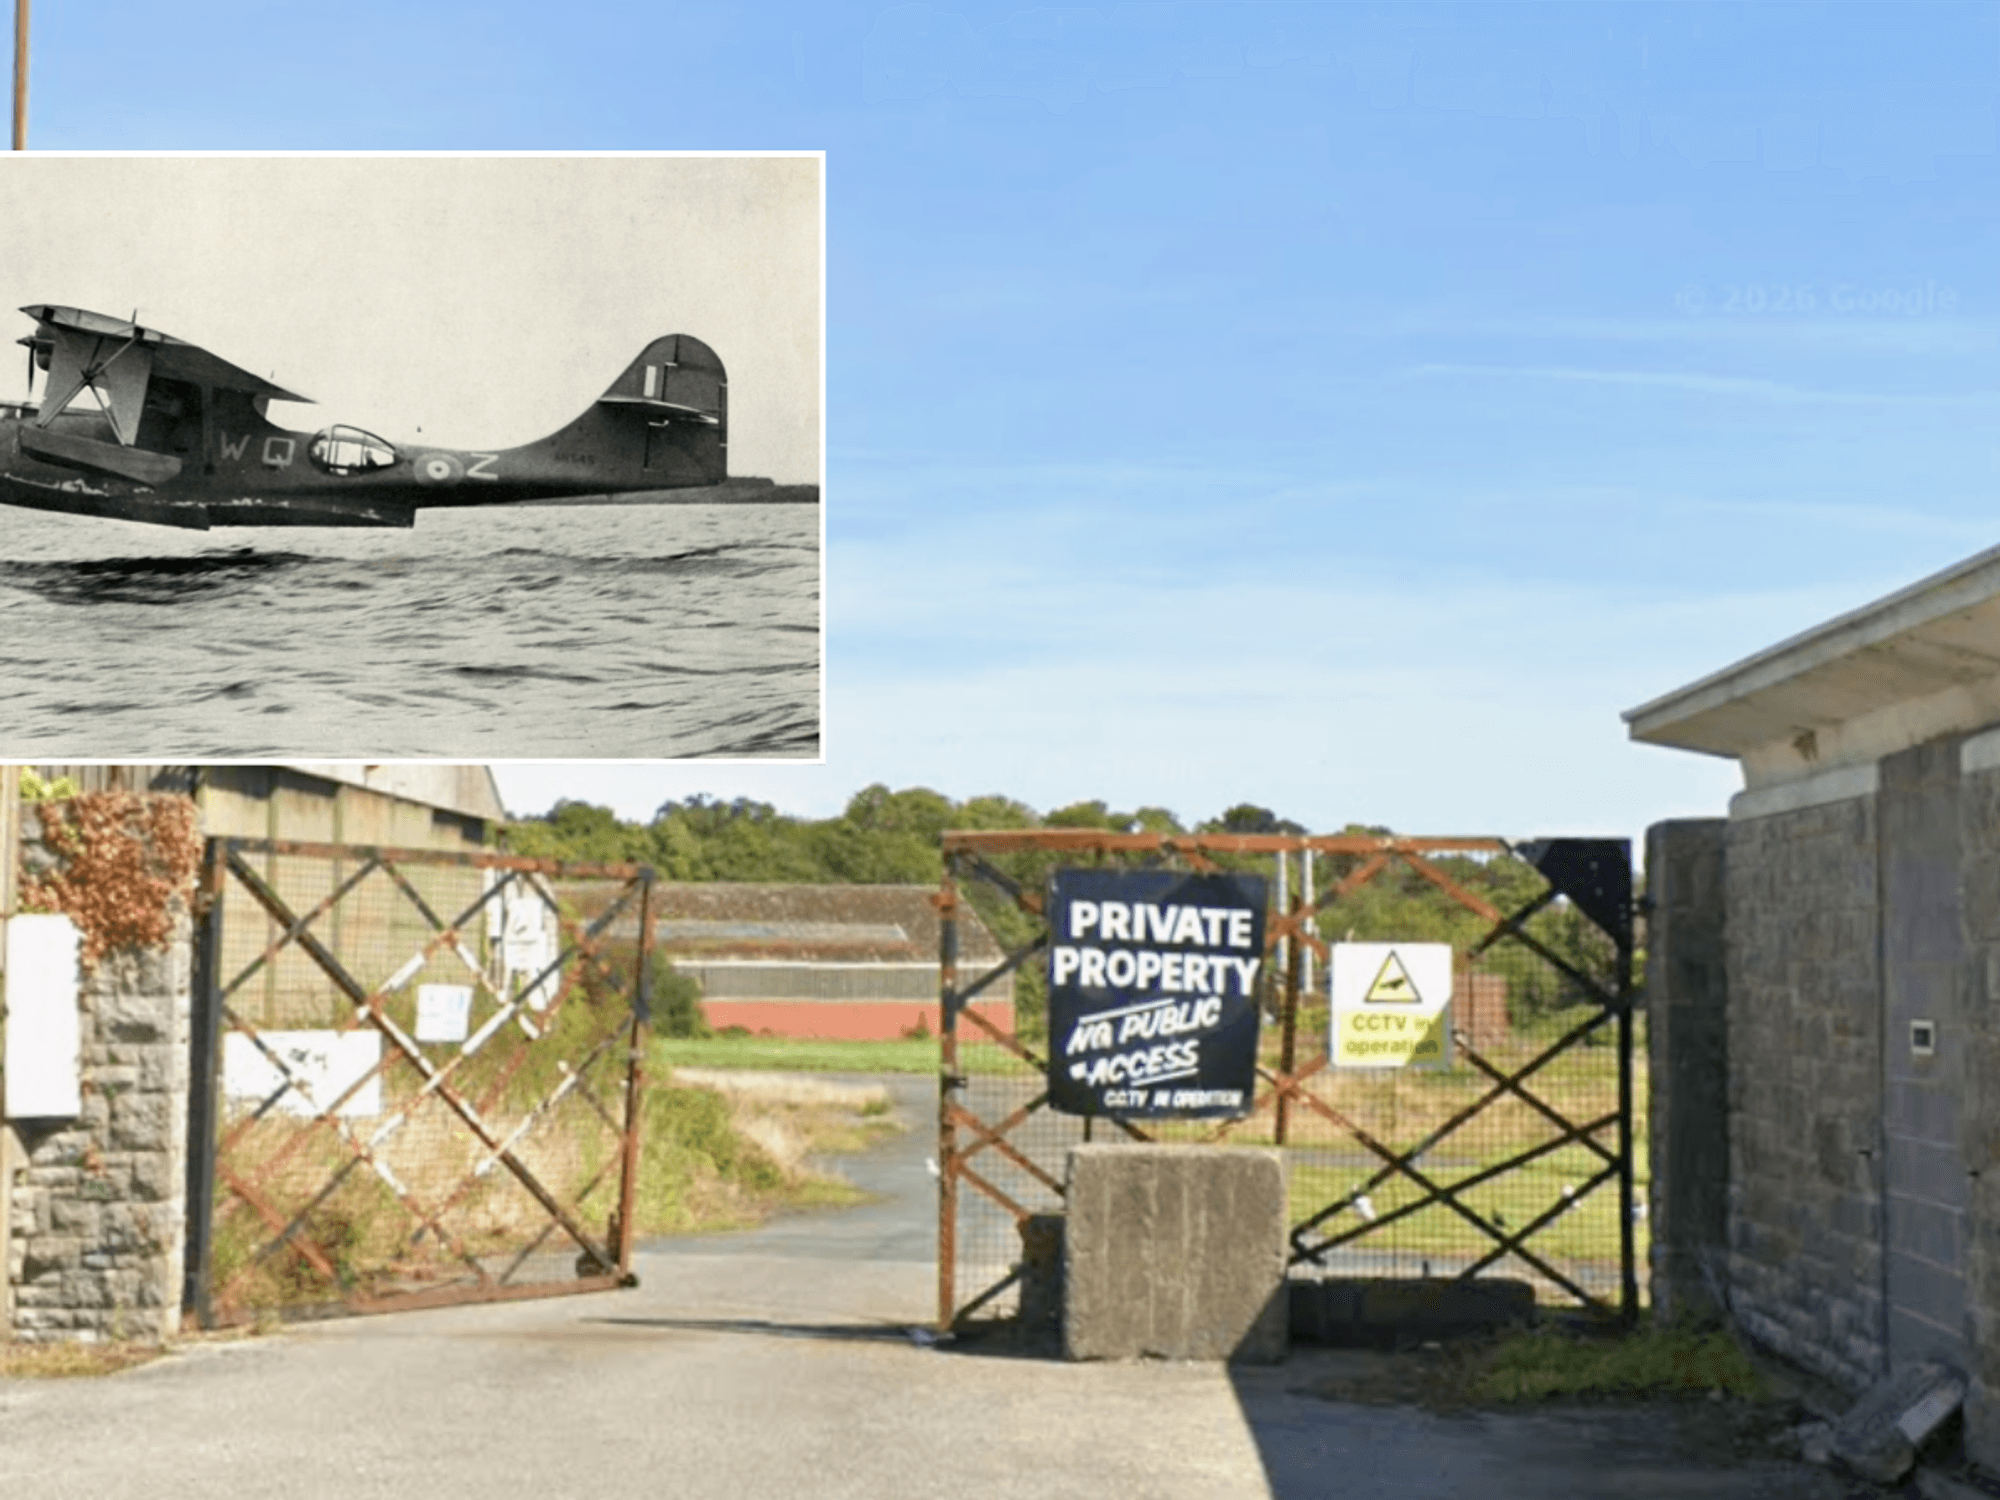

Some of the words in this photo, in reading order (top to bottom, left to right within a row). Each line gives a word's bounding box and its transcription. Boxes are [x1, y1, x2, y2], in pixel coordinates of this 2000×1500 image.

[466, 453, 499, 481] Z
[1070, 900, 1253, 947] PRIVATE
[1053, 946, 1261, 996] PROPERTY
[1117, 996, 1222, 1044] PUBLIC
[1351, 1013, 1407, 1031] CCTV
[1087, 1039, 1200, 1087] ACCESS
[1104, 1089, 1149, 1108] CCTV
